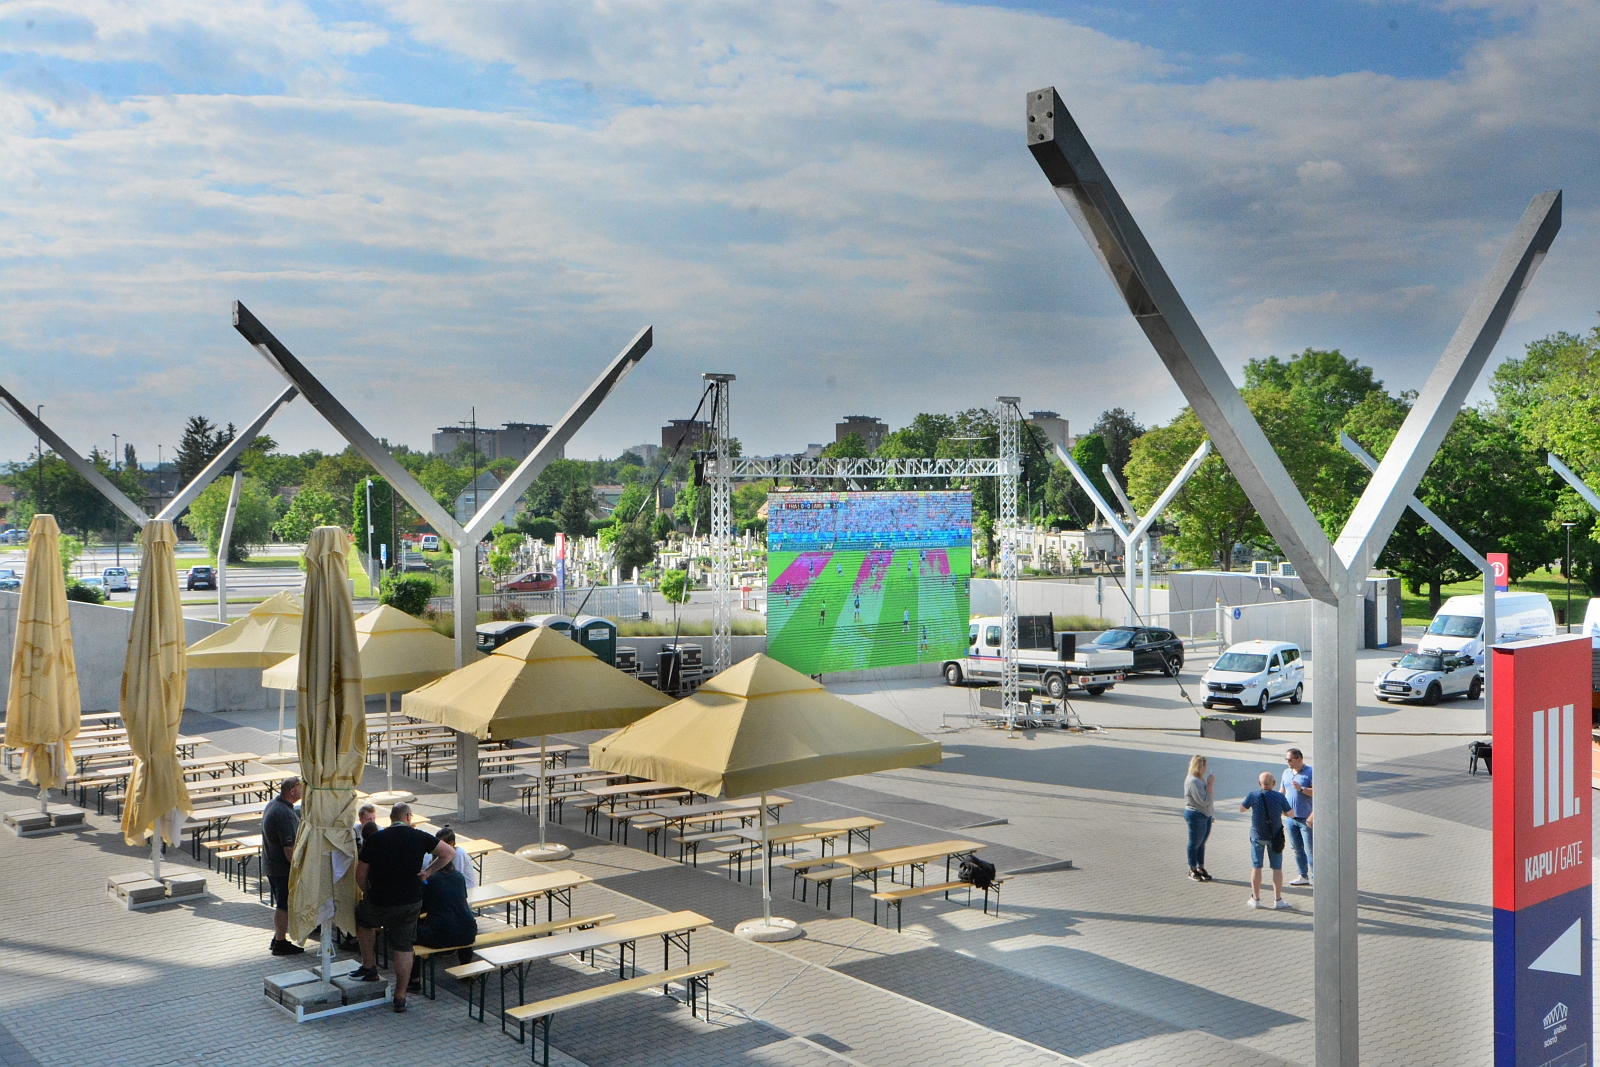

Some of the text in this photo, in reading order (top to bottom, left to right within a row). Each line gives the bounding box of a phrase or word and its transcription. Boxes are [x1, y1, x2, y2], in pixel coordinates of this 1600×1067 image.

[1532, 703, 1581, 828] III.
[1524, 849, 1553, 883] KAPU
[1560, 840, 1583, 871] GATE
[1553, 1023, 1568, 1036] ARÉNA
